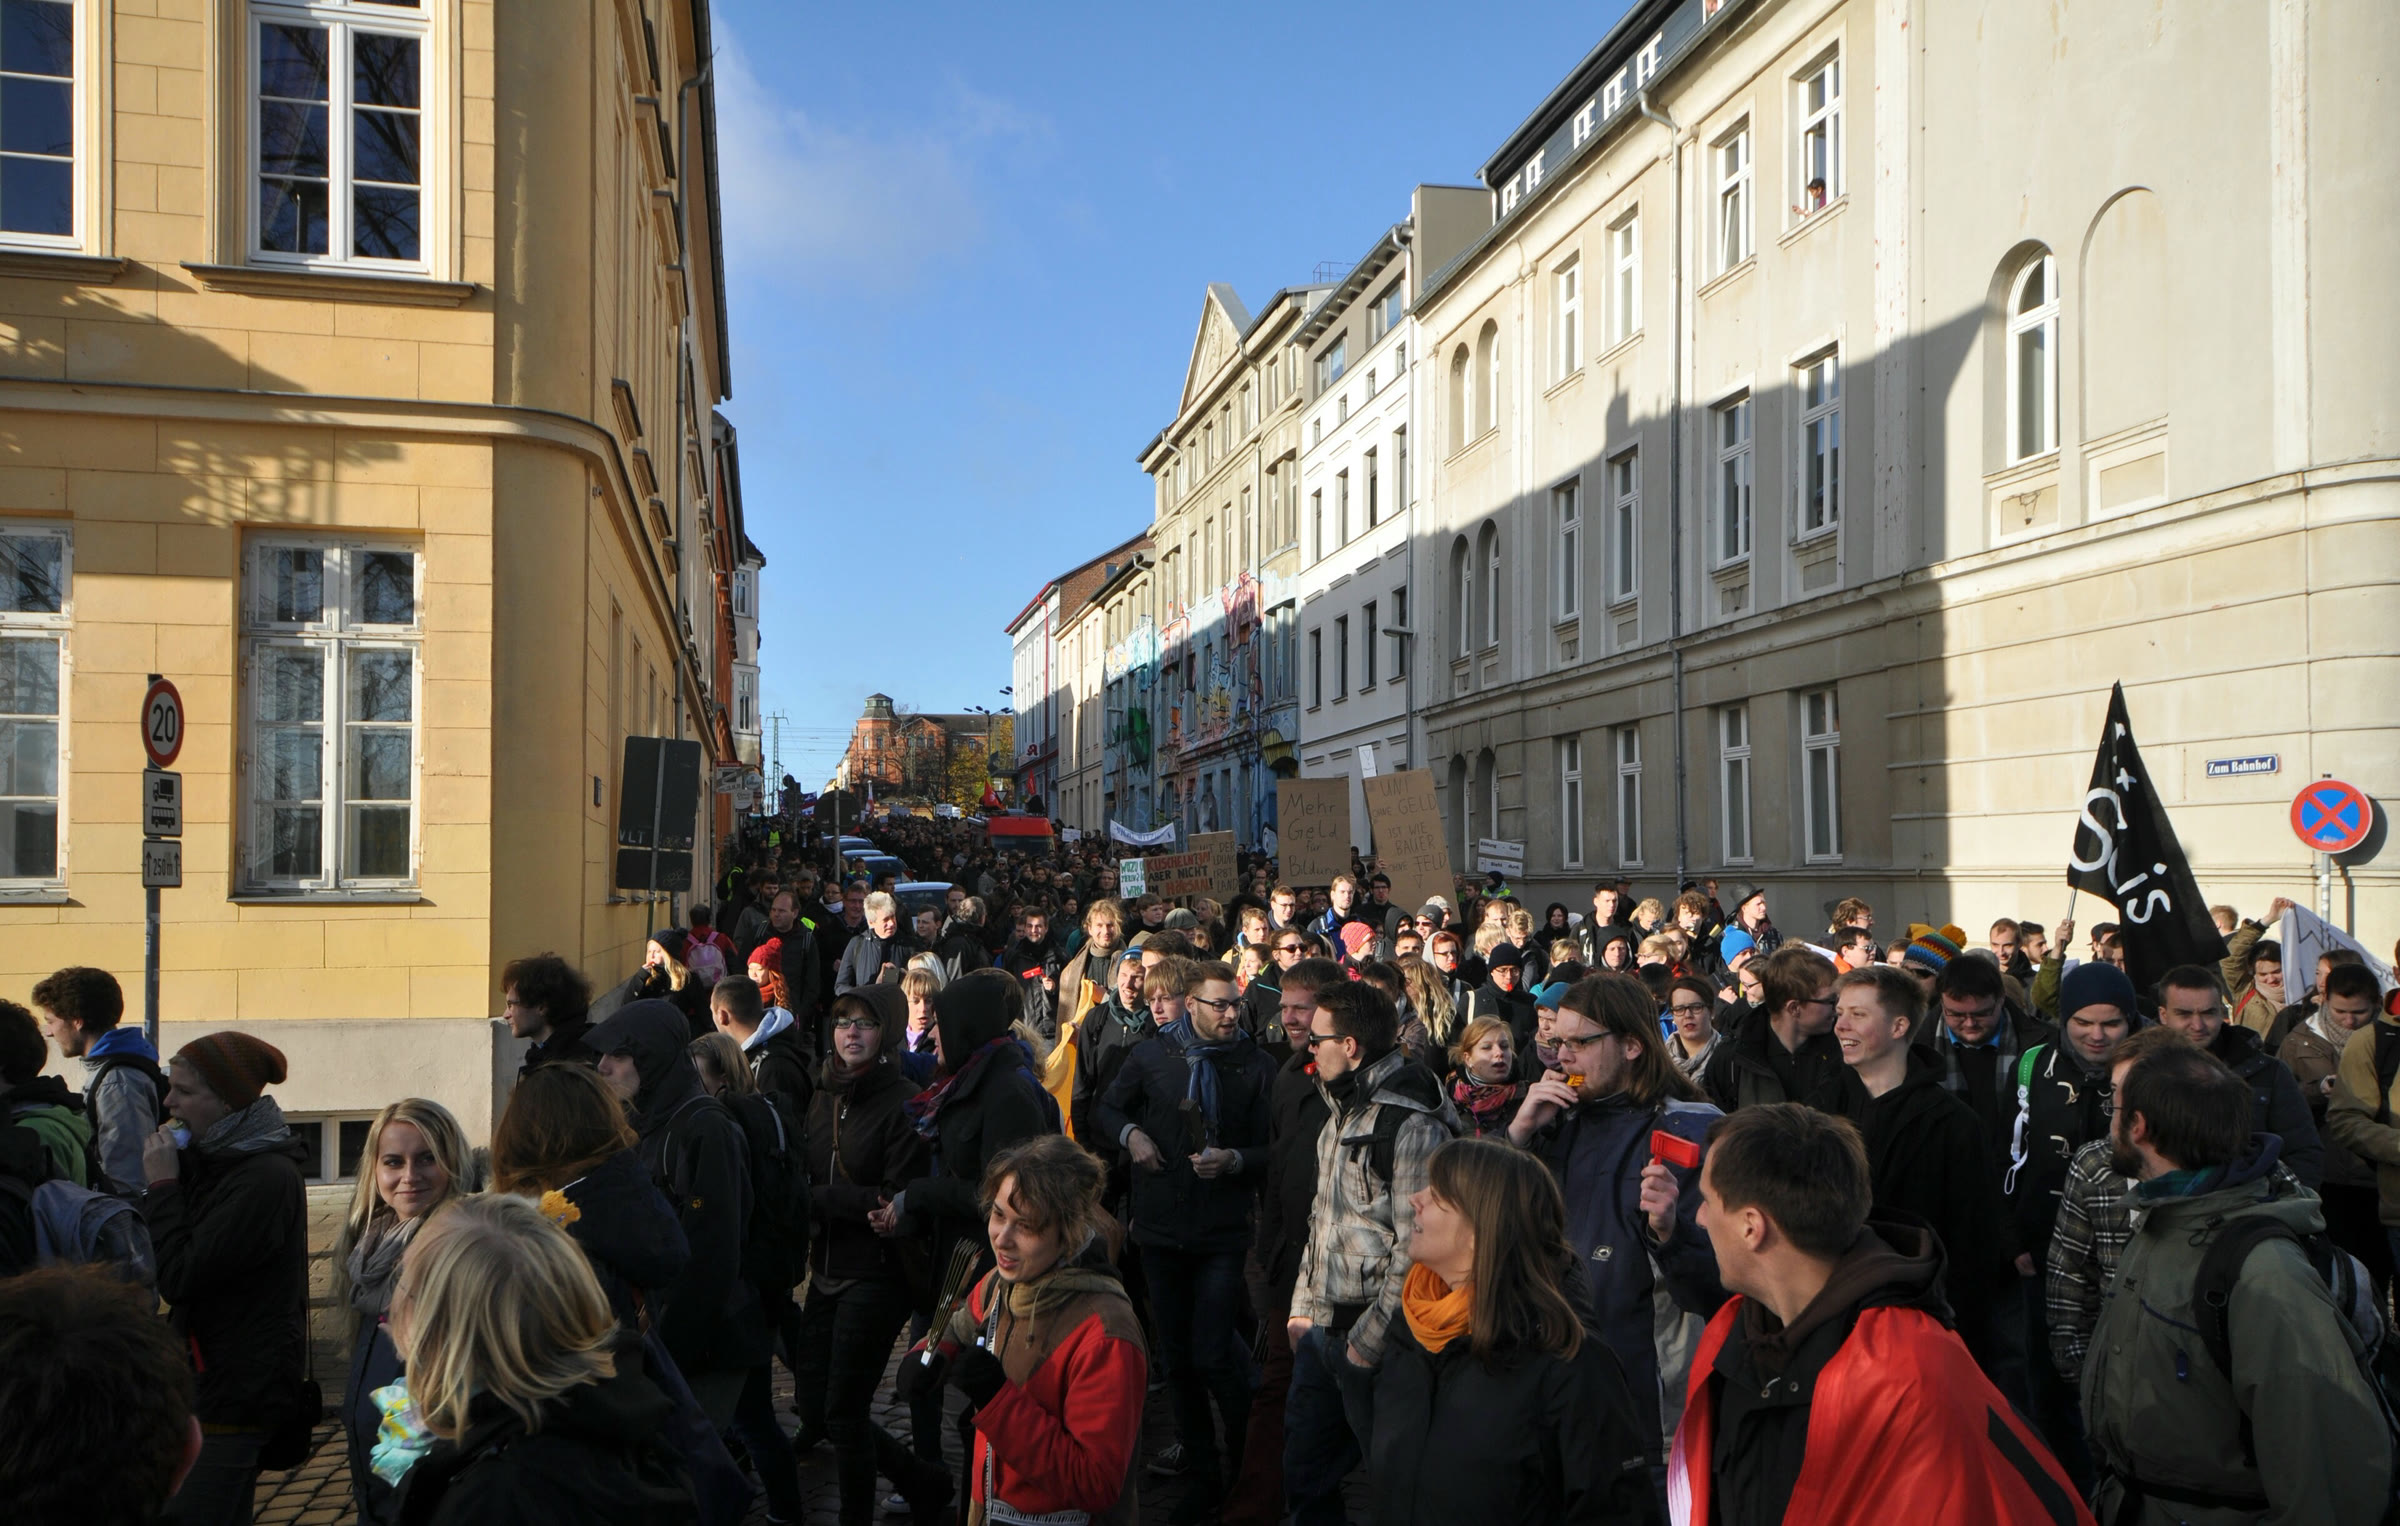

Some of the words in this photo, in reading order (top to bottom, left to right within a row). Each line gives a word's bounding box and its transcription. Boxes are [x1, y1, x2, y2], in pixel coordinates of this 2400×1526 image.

[152, 703, 176, 743] 20
[2208, 762, 2229, 775] Zum
[2231, 758, 2273, 773] Bahnhof
[1283, 792, 1336, 817] Mehr
[1372, 806, 1393, 818] OHNE
[1398, 793, 1437, 816] GELD
[1287, 817, 1339, 841] Geld
[1388, 826, 1403, 839] IST
[1408, 821, 1428, 835] WIE
[1219, 841, 1235, 853] DER
[1395, 834, 1436, 856] BAUER
[153, 858, 166, 877] 250
[1414, 851, 1447, 873] FELD
[1148, 870, 1172, 883] ABER
[1177, 865, 1208, 879] NICHT
[1147, 885, 1160, 896] IM
[1217, 878, 1238, 893] LAND
